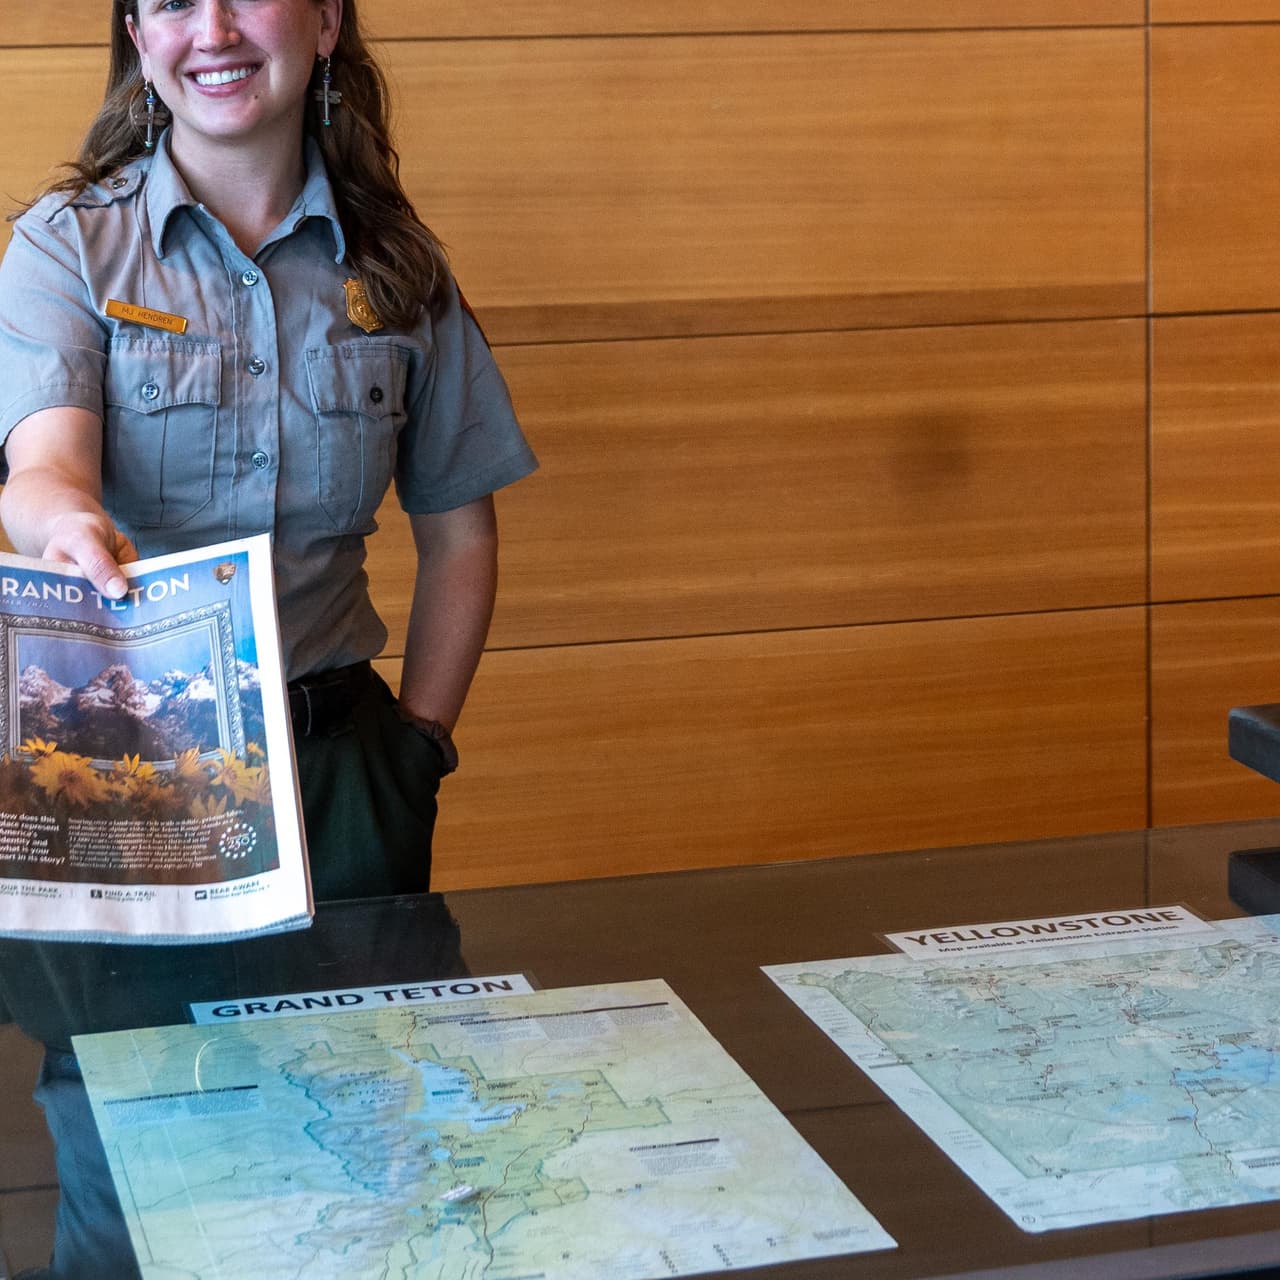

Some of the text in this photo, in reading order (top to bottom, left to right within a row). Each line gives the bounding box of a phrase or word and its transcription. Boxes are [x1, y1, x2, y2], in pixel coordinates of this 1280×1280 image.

[19, 813, 39, 823] does
[40, 815, 56, 825] this
[32, 839, 49, 847] and
[904, 910, 1184, 946] YELLOWSTONE
[938, 945, 964, 954] Map
[966, 939, 1013, 951] available
[1027, 932, 1093, 944] Yellowstone
[1094, 928, 1140, 938] Entrance
[1141, 925, 1180, 933] Station
[212, 979, 514, 1018] GRAND TETON
